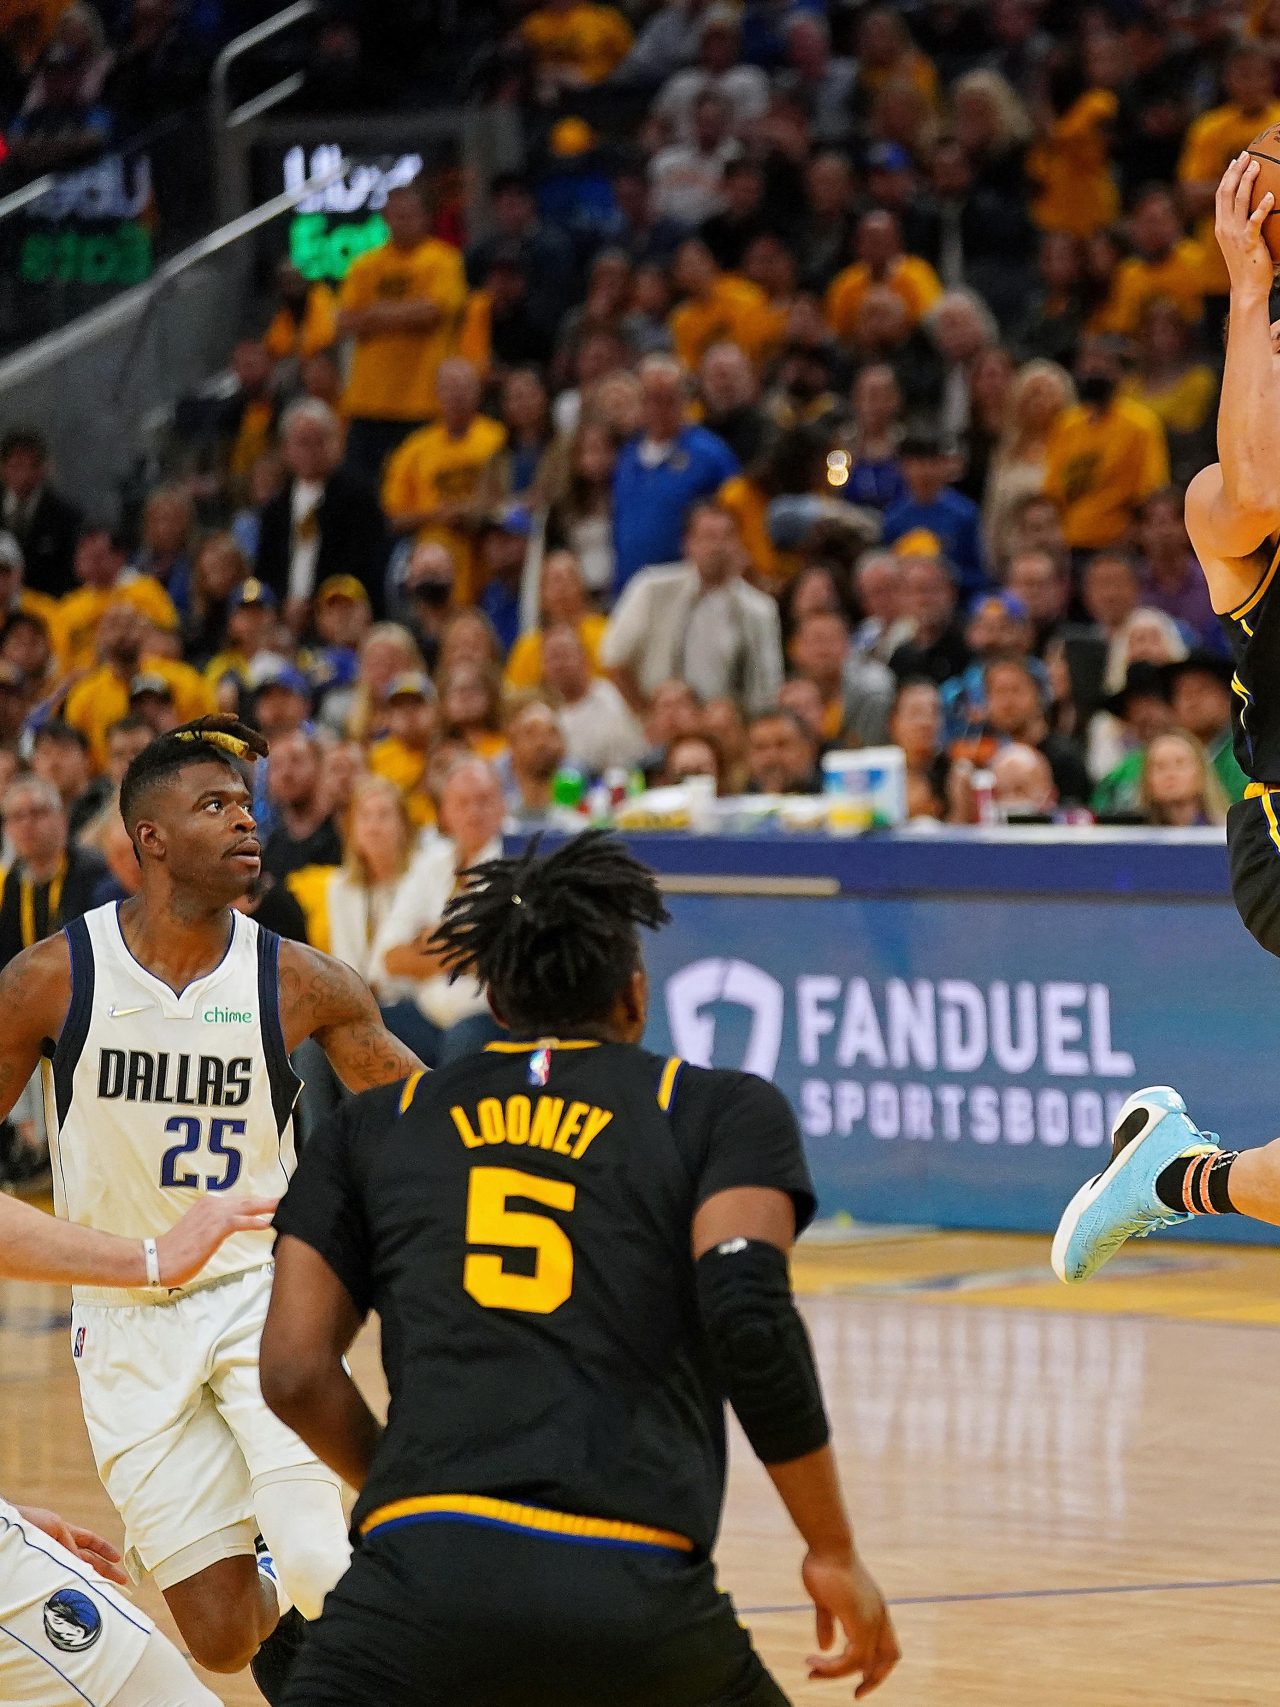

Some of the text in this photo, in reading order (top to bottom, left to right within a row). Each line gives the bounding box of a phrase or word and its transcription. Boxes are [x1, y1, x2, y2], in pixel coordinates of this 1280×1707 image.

[204, 1006, 253, 1024] chime
[795, 974, 1137, 1078] FANDUEL
[96, 1047, 253, 1108] DALLAS
[159, 1115, 248, 1192] 25
[450, 1094, 614, 1160] LOONEY
[462, 1165, 577, 1314] 5
